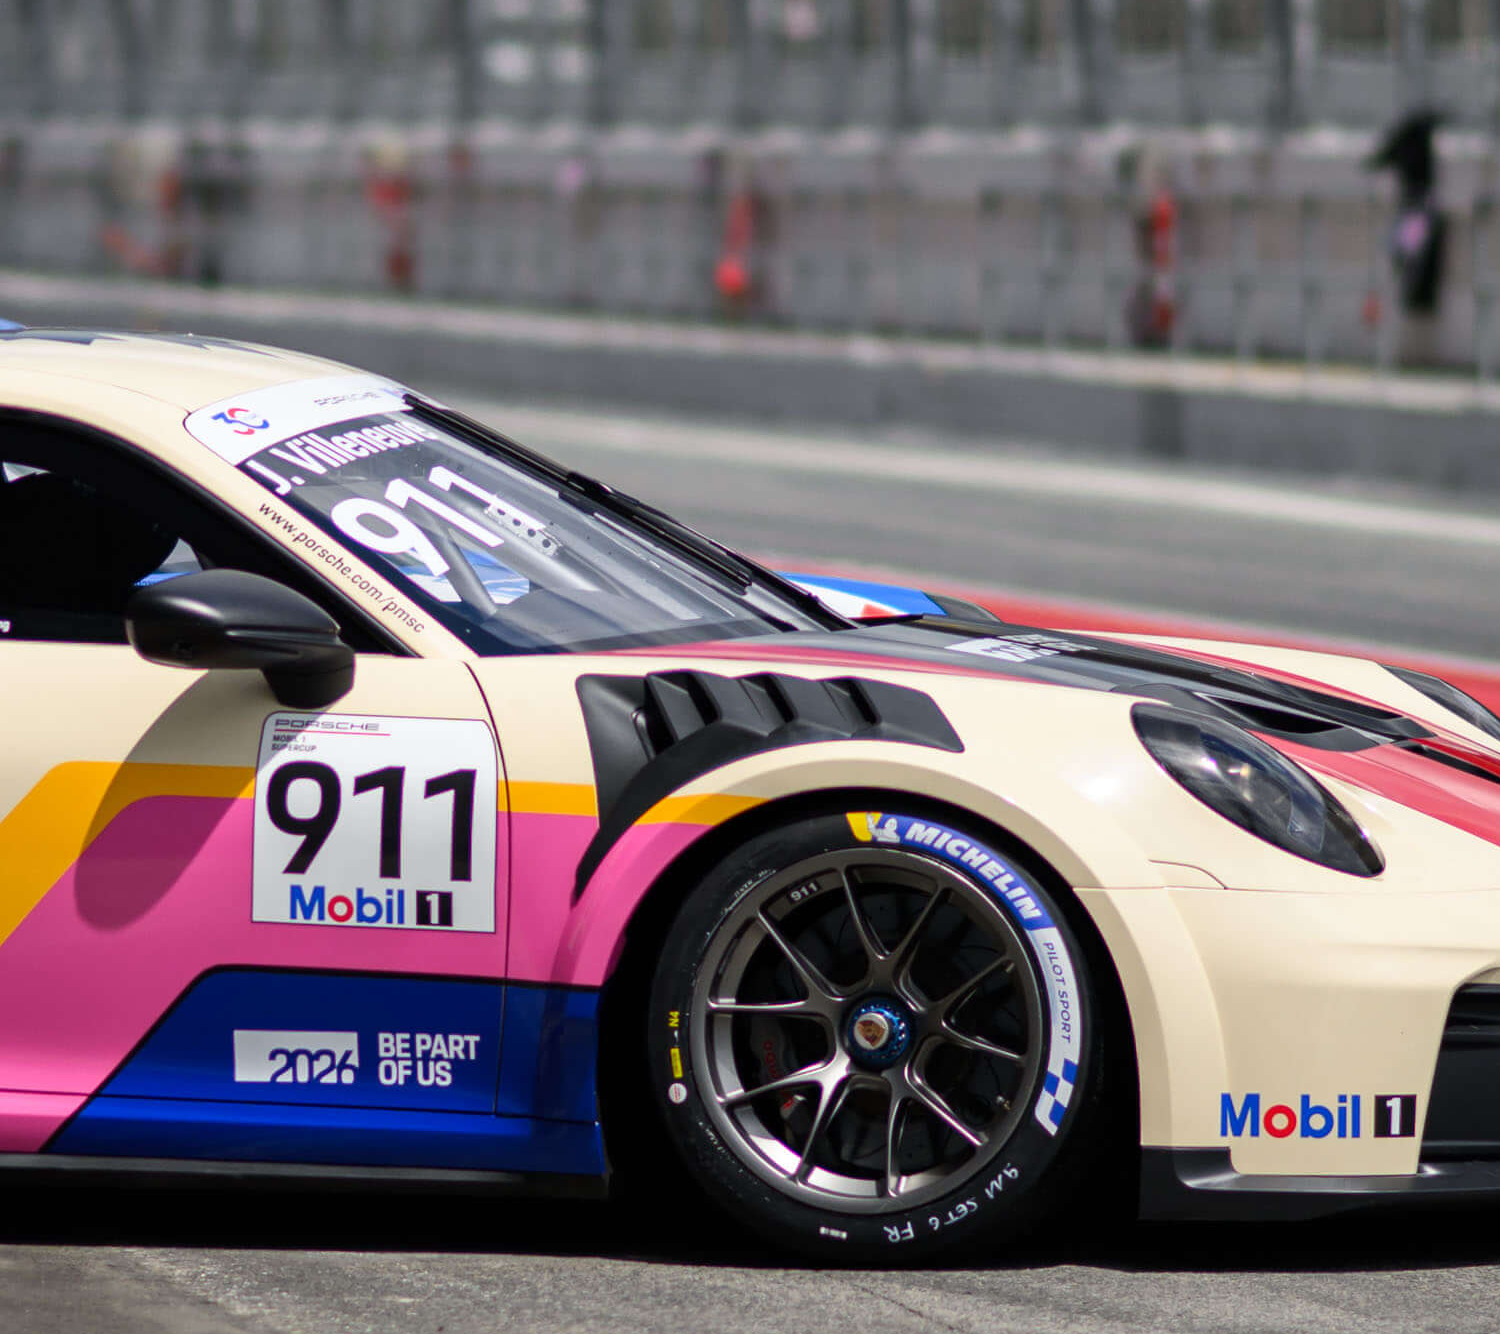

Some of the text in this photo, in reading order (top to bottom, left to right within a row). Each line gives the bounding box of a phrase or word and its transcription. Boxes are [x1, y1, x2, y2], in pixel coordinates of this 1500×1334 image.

[268, 419, 438, 476] Villeneuve
[245, 459, 306, 496] J.
[330, 465, 549, 578] 911
[258, 500, 427, 634] www.porsche.com/pmsc
[274, 719, 380, 732] PORSCHE
[271, 742, 317, 752] SUPERCUP
[265, 759, 478, 882] 911
[289, 885, 406, 925] Mobil
[790, 881, 819, 902] 911
[905, 821, 1072, 1045] MICHELIN PILOT SPORT
[668, 1010, 680, 1027] N4
[377, 1032, 481, 1059] BE PART
[268, 1048, 359, 1082] 2026
[378, 1060, 453, 1087] OF US
[1220, 1092, 1361, 1138] Mobil
[883, 1220, 915, 1243] FR
